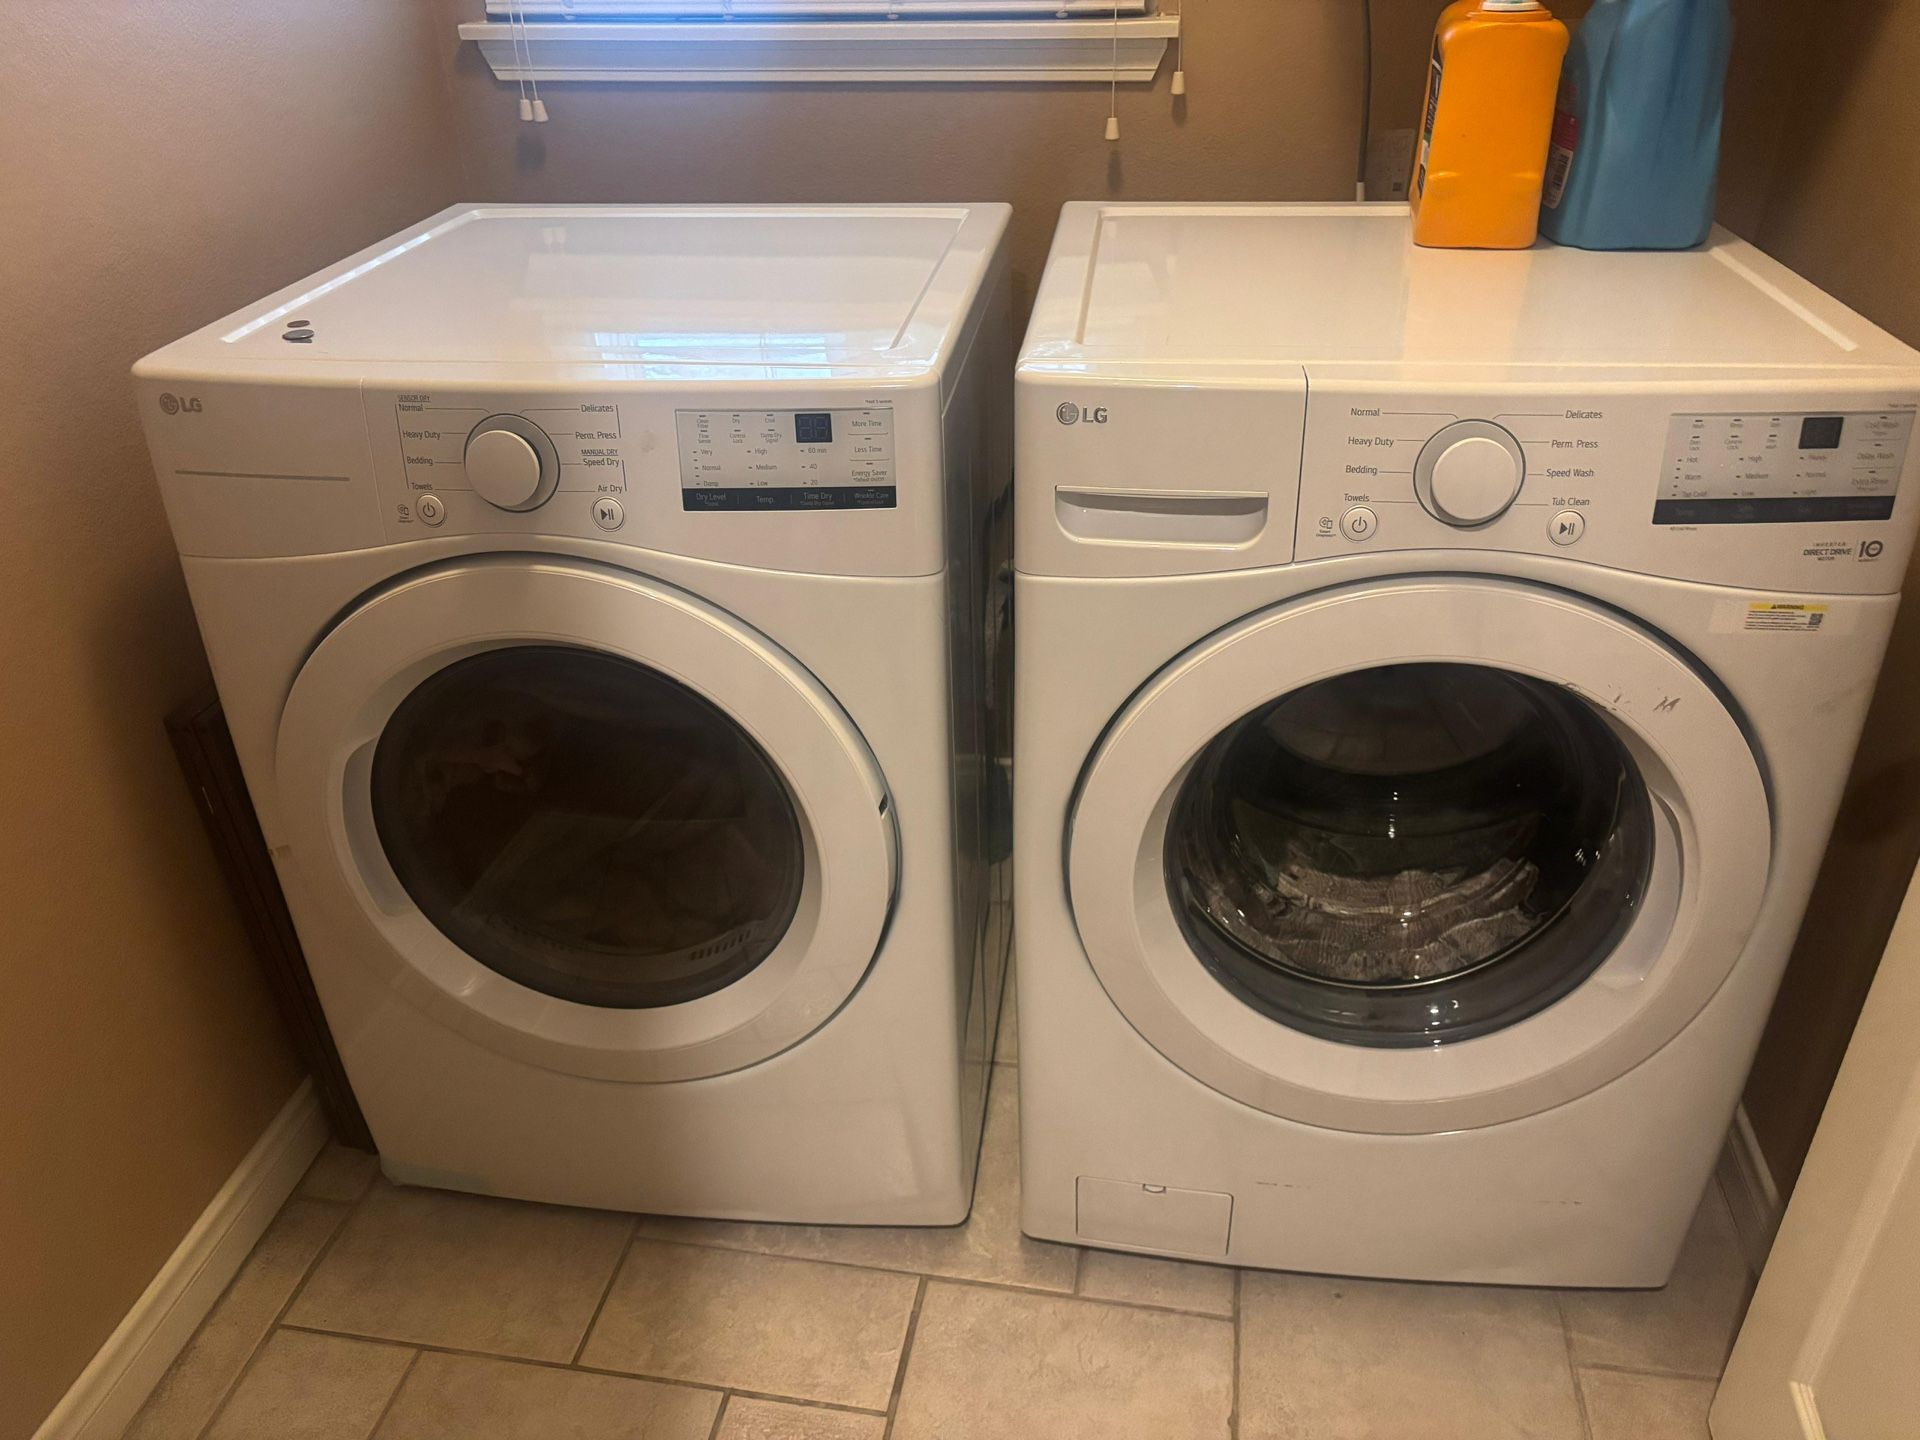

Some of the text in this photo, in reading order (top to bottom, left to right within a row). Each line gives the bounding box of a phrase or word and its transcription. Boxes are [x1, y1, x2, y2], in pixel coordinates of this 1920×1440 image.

[179, 396, 202, 412] LG
[398, 403, 424, 412] Normal
[580, 404, 614, 412] Delicates
[1082, 407, 1108, 423] LG
[1350, 407, 1380, 417] Normal
[1565, 410, 1603, 419] Delicates
[402, 430, 441, 440] Heavy Duty
[575, 431, 617, 440] Perm. Press
[1348, 436, 1394, 448] Heavy Duty
[1551, 439, 1599, 449] Perm. Press
[581, 448, 618, 456] MANUAL DRY
[754, 448, 768, 456] High
[406, 456, 433, 466] Bedding
[583, 458, 620, 468] Speed Dry
[851, 469, 887, 478] Energy Saver
[1345, 465, 1378, 476] Bedding
[1546, 468, 1595, 480] Speed Wash
[411, 482, 433, 491] Towels
[609, 485, 623, 494] Dry
[695, 493, 708, 501] Dry
[803, 492, 833, 501] Time Dry
[1343, 493, 1370, 502] Towels
[1551, 497, 1590, 506] Tub Clean
[1803, 547, 1852, 556] DIRECT DRIVE
[1858, 540, 1884, 558] 10
